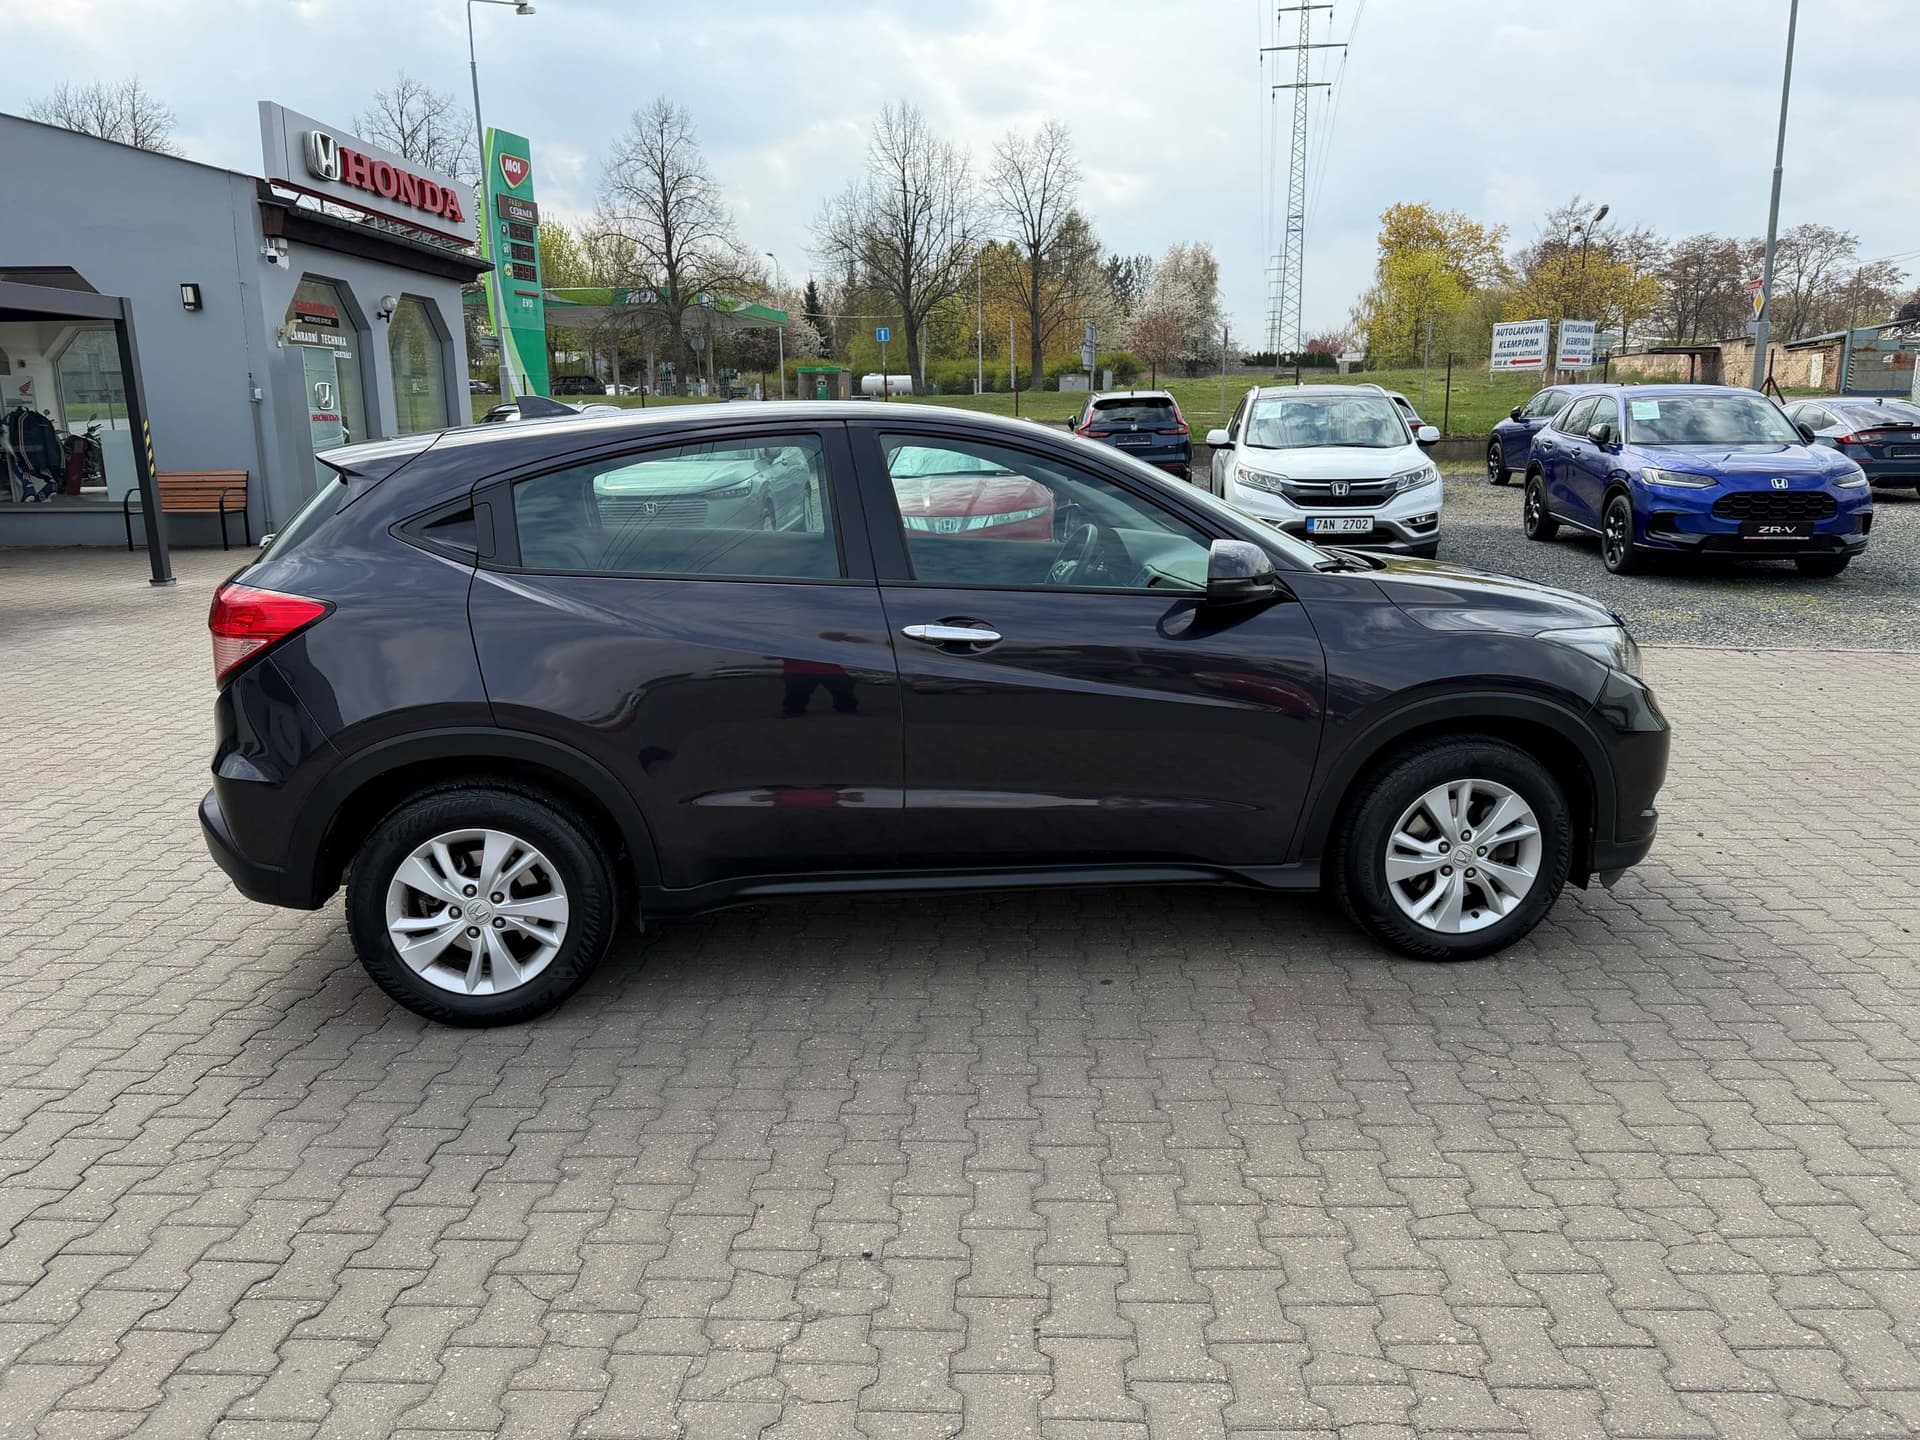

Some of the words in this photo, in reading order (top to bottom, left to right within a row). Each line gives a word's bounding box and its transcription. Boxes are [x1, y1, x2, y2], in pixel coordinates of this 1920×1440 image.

[505, 158, 521, 174] MOL
[339, 147, 465, 223] HONDA
[1495, 325, 1544, 337] AUTOLAKOVNA
[320, 333, 347, 347] TECHNIKA
[1499, 336, 1539, 349] KLEMPÍRNA
[1316, 519, 1335, 530] 7AN
[1343, 519, 1368, 530] 2702
[1758, 525, 1797, 534] ZR-V
